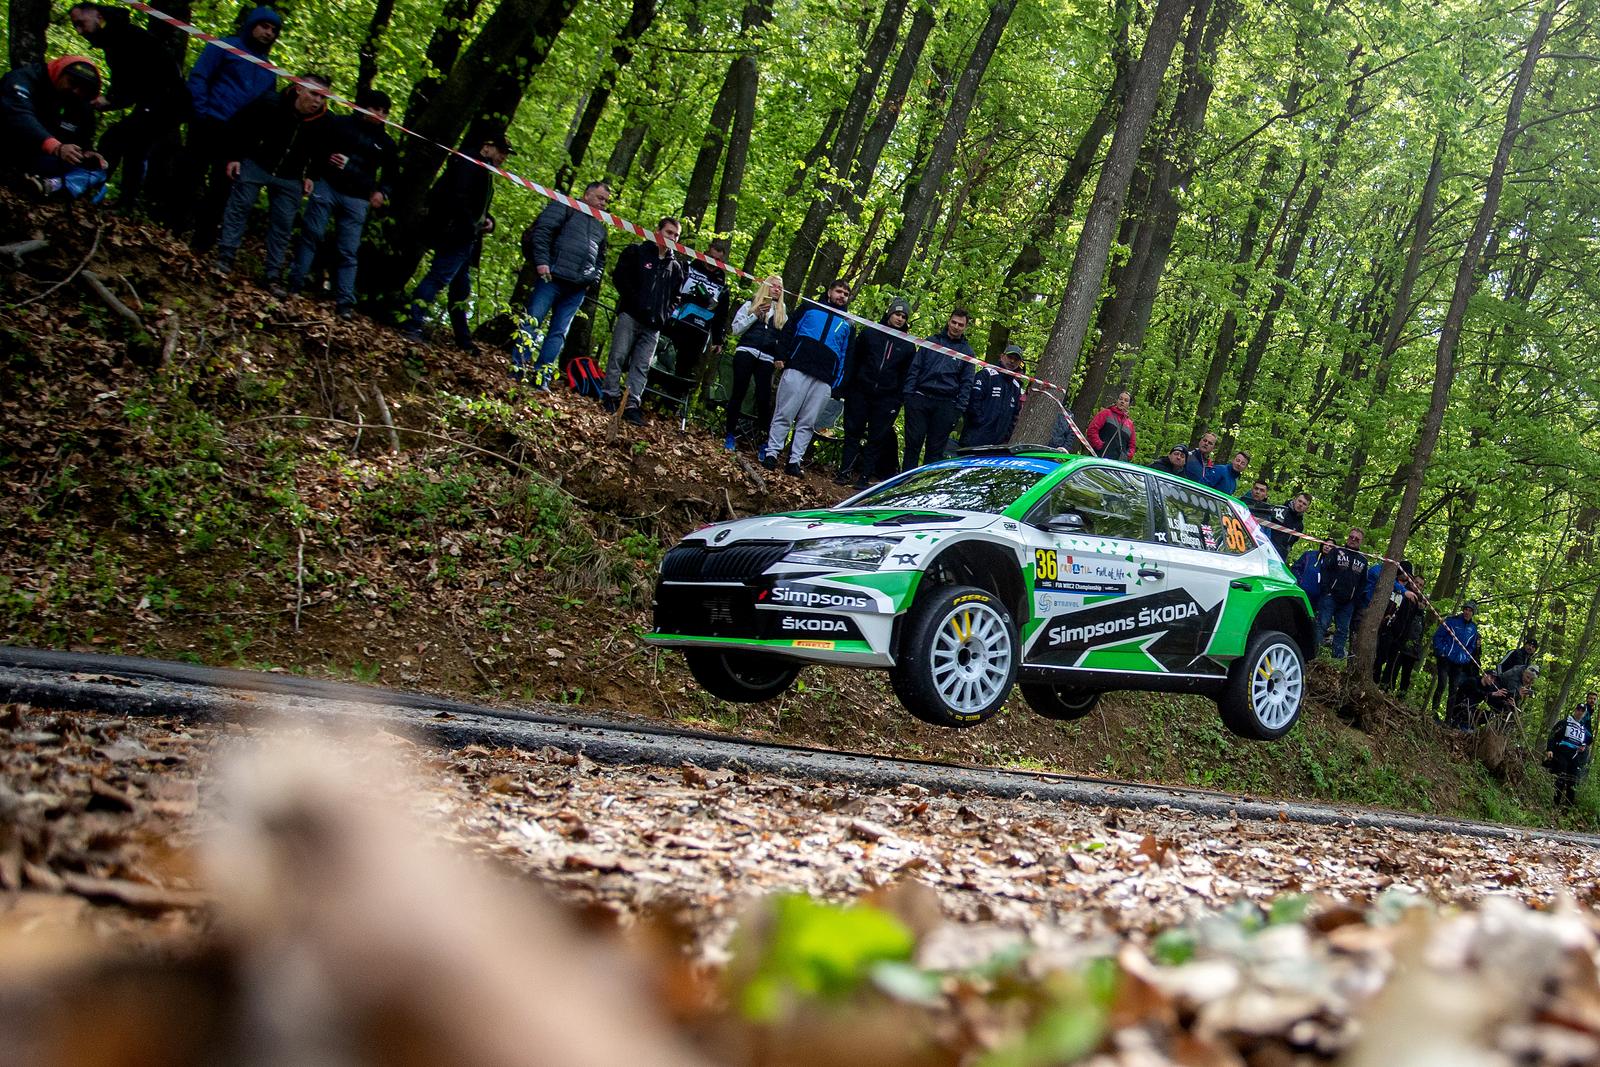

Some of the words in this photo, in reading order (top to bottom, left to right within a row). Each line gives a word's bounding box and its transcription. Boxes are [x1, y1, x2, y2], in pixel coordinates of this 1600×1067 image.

[1222, 516, 1245, 552] 36
[1036, 549, 1058, 580] 36
[771, 587, 867, 607] Simpsons
[1075, 583, 1102, 591] Championship
[782, 616, 848, 632] ŠKODA
[1049, 616, 1136, 646] Simpsons
[1138, 602, 1199, 627] ŠKODA
